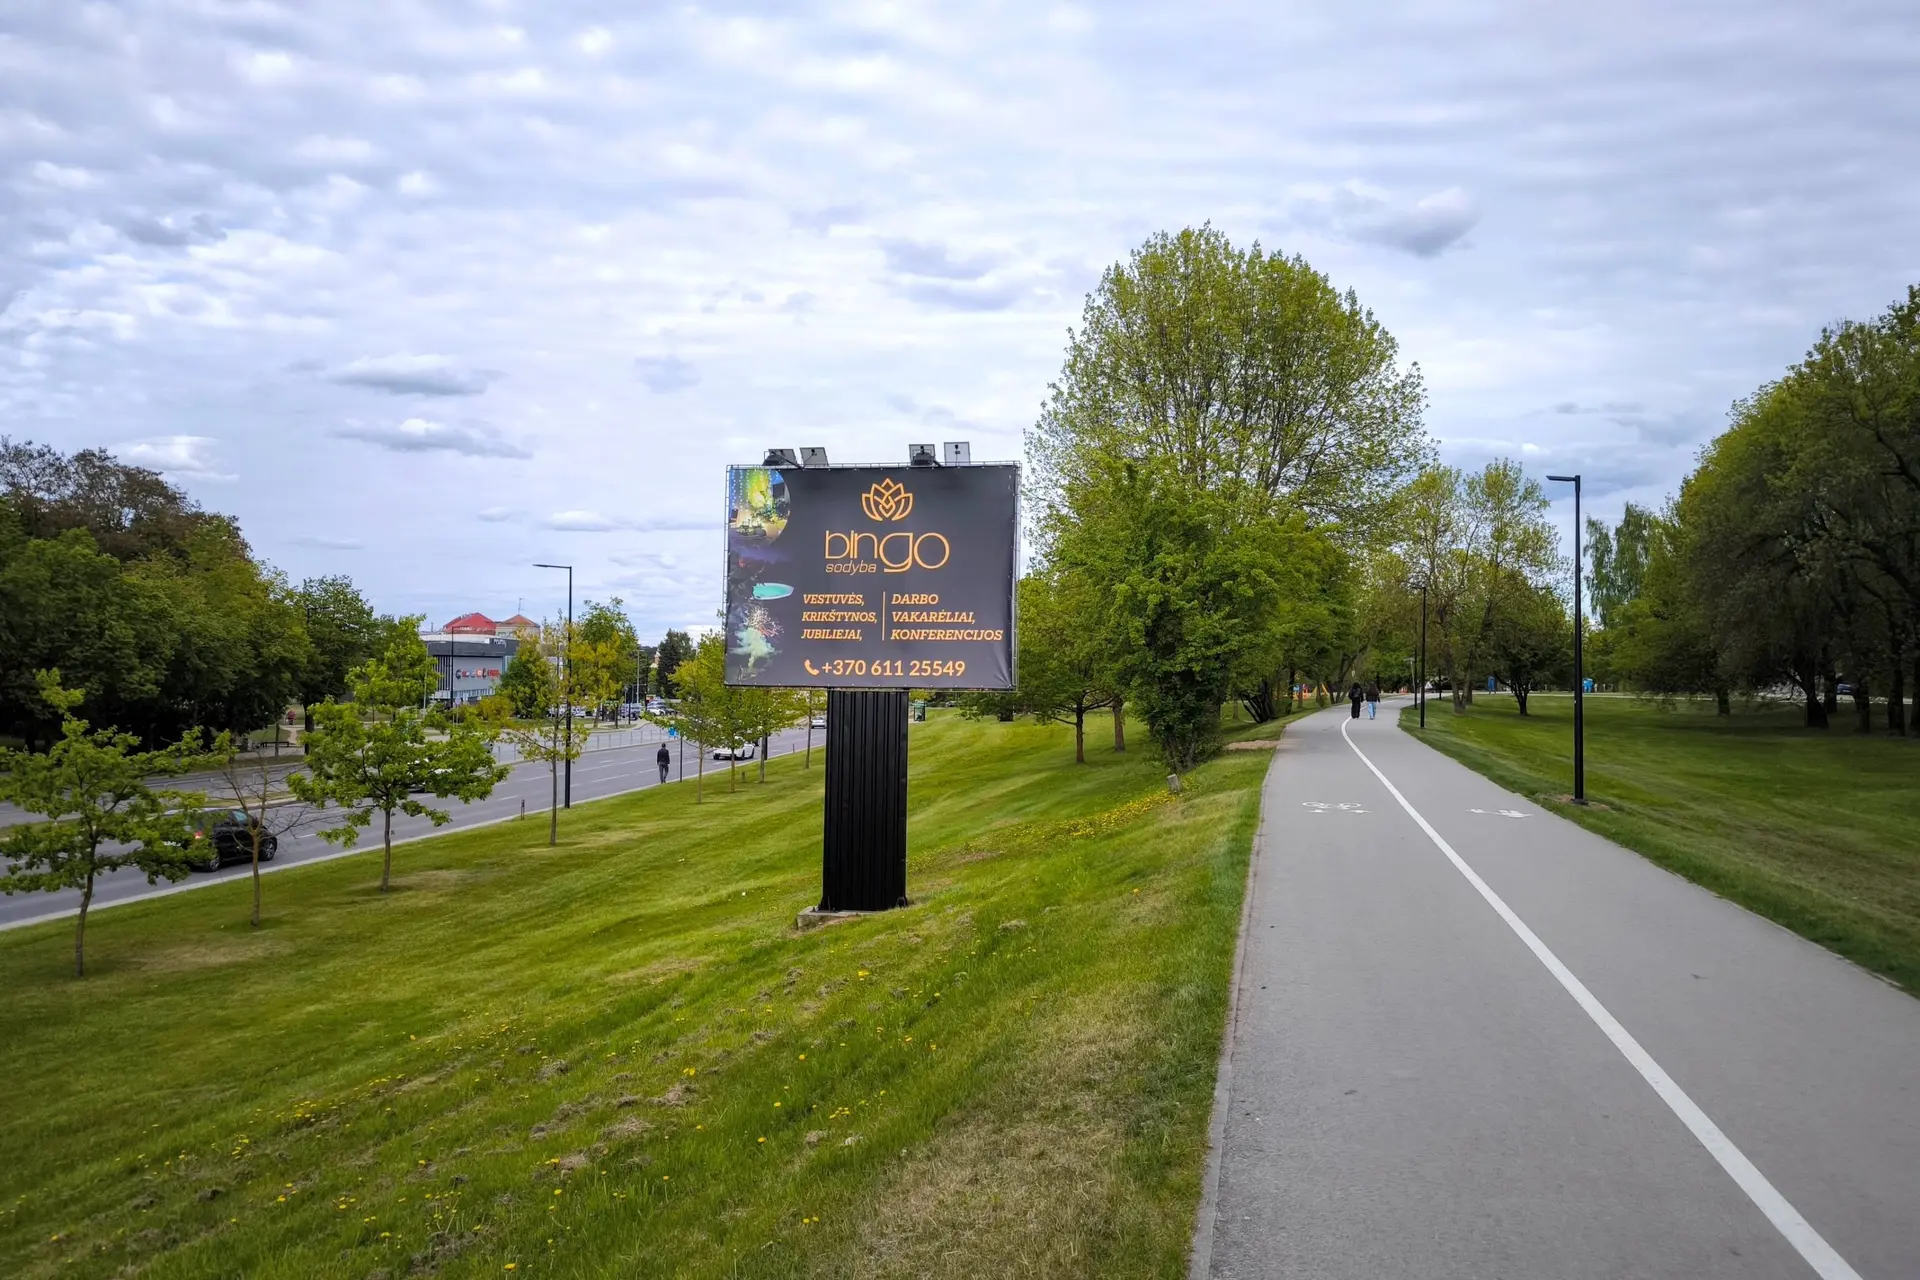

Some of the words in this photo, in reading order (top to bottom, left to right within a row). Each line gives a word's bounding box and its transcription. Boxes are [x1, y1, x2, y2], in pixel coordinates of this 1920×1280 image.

[825, 530, 950, 573] bingo
[825, 559, 877, 576] sodyba
[803, 592, 865, 607] VESTUVĖS,
[891, 593, 939, 605] DARBO
[801, 608, 878, 624] KRIKŠTYNOS,
[892, 609, 976, 624] VAKARĖLIAI,
[801, 629, 863, 642] JUBILIEJAI,
[890, 629, 1004, 641] KONFERENCIJOS
[822, 660, 866, 677] +370
[871, 660, 904, 677] 611
[909, 660, 966, 677] 25549
